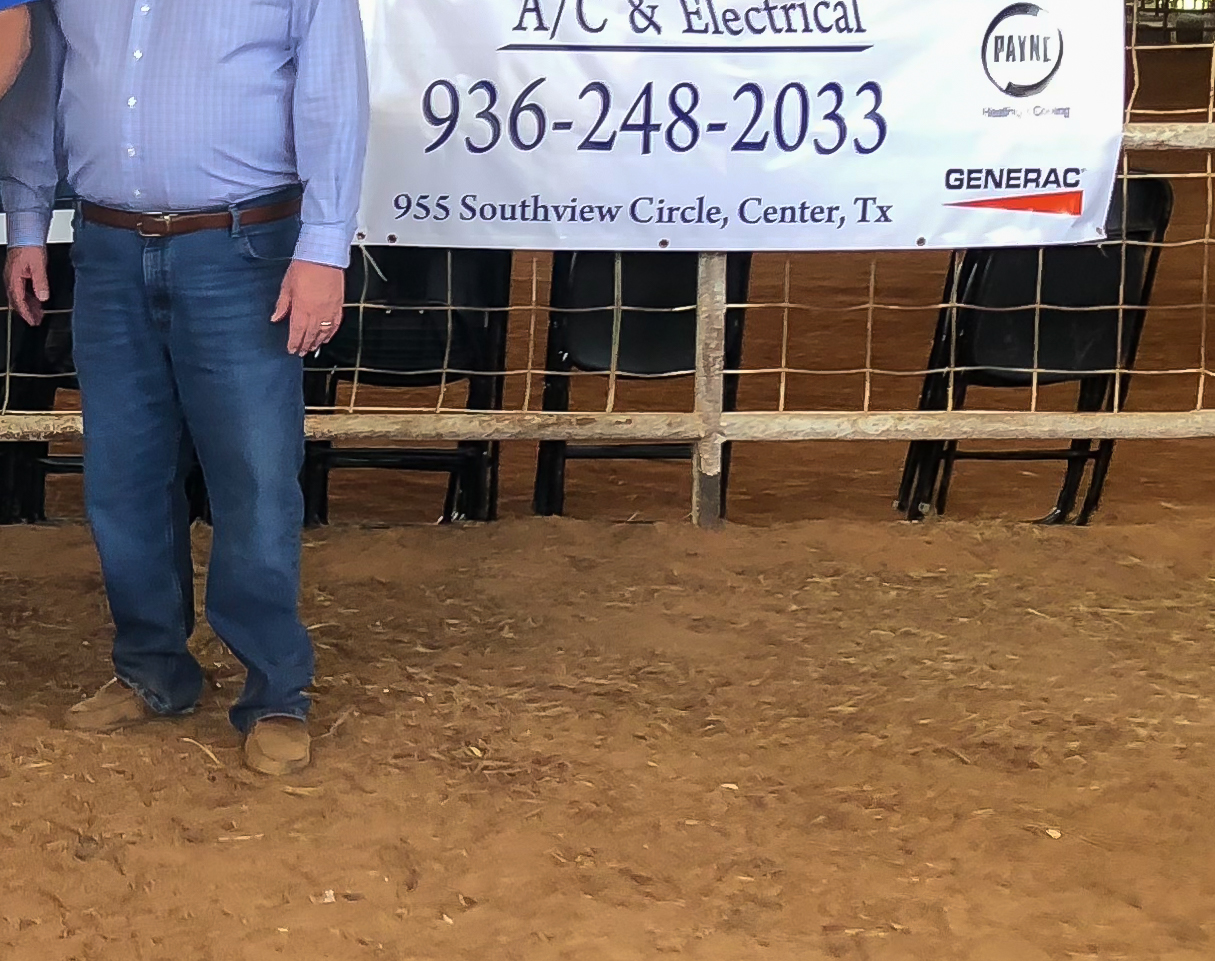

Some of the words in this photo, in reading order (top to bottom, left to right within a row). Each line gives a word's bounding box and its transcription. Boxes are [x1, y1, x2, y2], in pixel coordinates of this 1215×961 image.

[422, 77, 888, 156] 936-248-2033
[944, 167, 1081, 190] GENERAC
[393, 193, 451, 221] 955
[459, 194, 621, 224] Southview
[629, 196, 729, 229] Circle,
[738, 197, 846, 229] Center,
[854, 198, 893, 224] Tx
